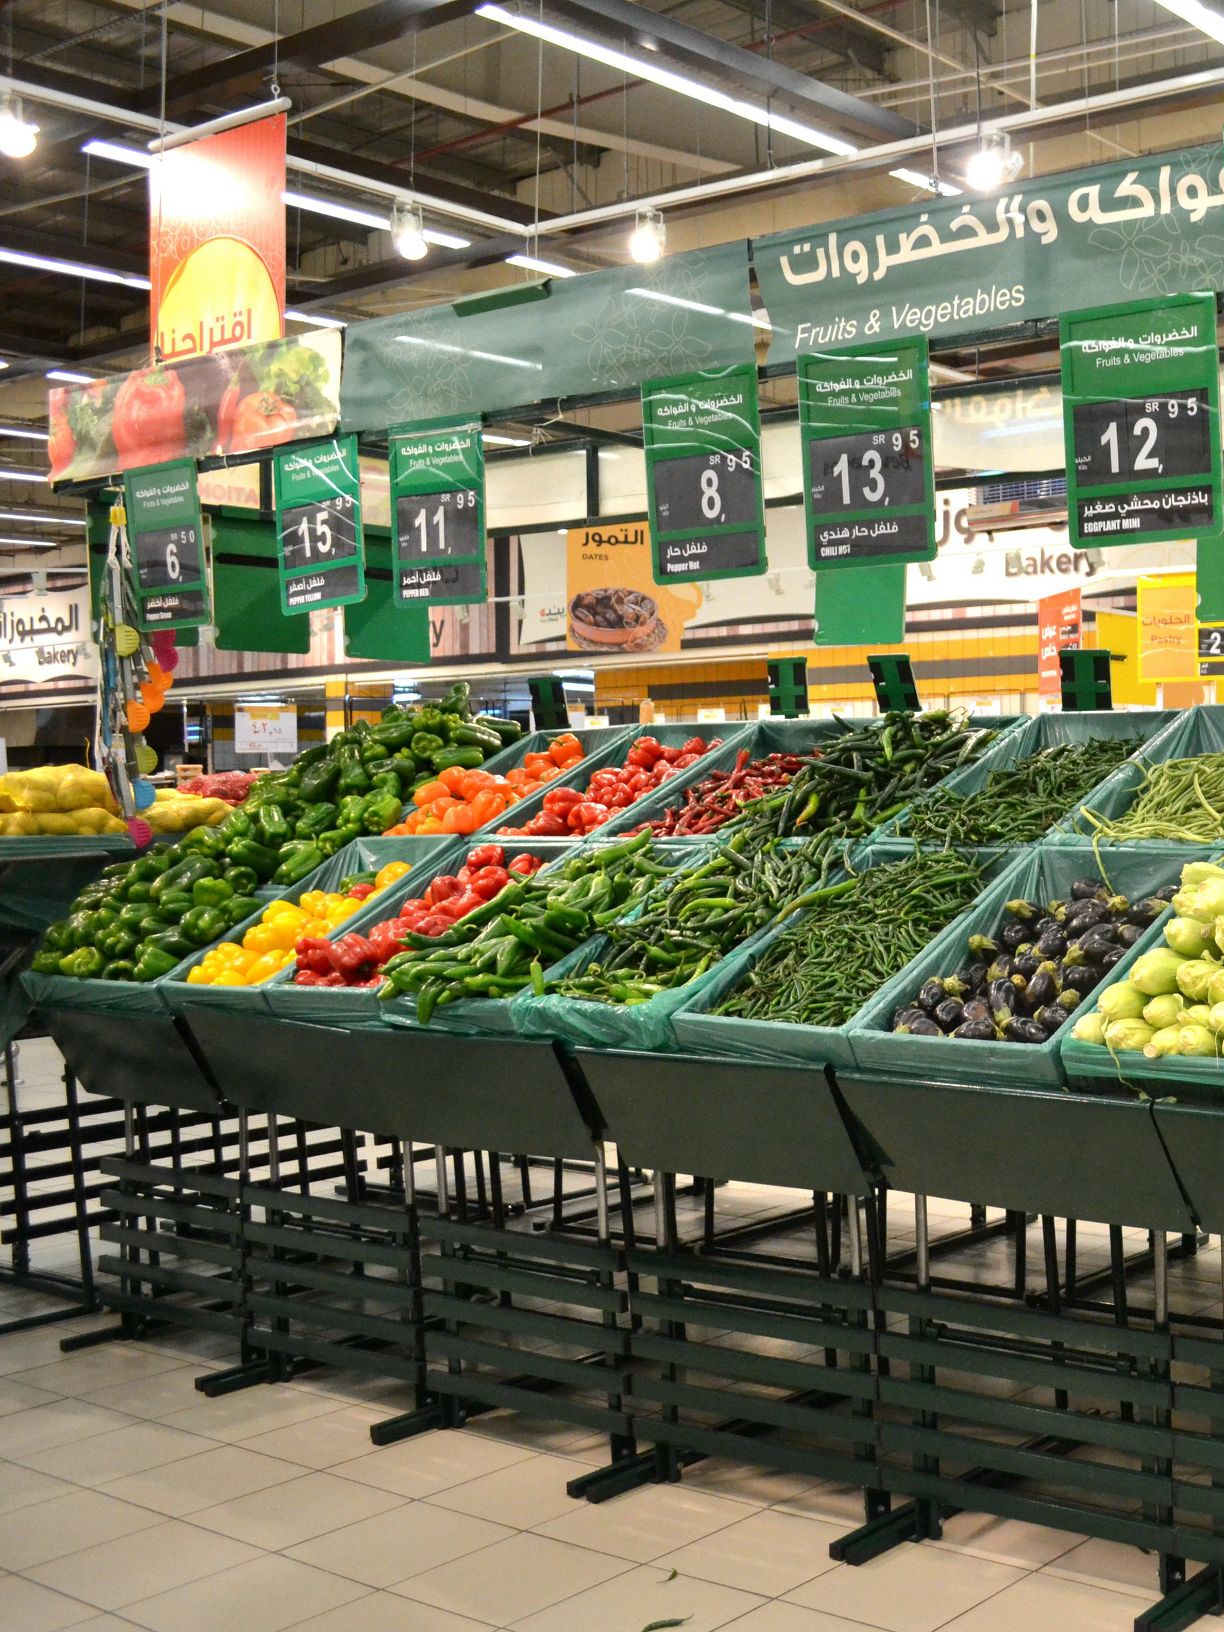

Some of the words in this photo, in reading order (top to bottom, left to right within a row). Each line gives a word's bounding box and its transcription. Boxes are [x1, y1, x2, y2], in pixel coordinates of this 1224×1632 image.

[795, 318, 857, 348] Fruits
[864, 310, 881, 334] &
[892, 284, 1024, 332] Vegetables
[1139, 326, 1197, 344] الخضروات
[1096, 357, 1121, 367] Fruits
[1124, 354, 1130, 364] &
[1133, 348, 1184, 363] Vegetables
[864, 369, 913, 386] الخضروات
[828, 396, 849, 406] Fruits
[851, 394, 857, 403] &
[859, 388, 901, 402] Vegetables
[658, 402, 689, 416] الفواكه
[1145, 402, 1159, 412] SR
[668, 416, 687, 428] Fruits
[688, 416, 693, 426] &
[695, 412, 734, 425] Vegetables
[873, 434, 885, 445] SR
[401, 444, 427, 456] الفواكه
[409, 458, 425, 467] Fruits
[426, 456, 430, 466] &
[431, 454, 463, 466] Vegetables
[709, 456, 720, 465] SR
[441, 493, 450, 502] SR
[1118, 495, 1160, 515] محشي
[1162, 491, 1208, 507] باذنجان
[1084, 500, 1115, 516] صغير
[852, 525, 868, 539] حار
[870, 521, 898, 536] فلفل
[1084, 520, 1120, 533] EGGPLANT
[1122, 518, 1140, 529] MINI
[582, 529, 643, 547] التمور
[820, 527, 849, 544] هندي
[667, 545, 681, 558] حار
[682, 542, 707, 557] فلفل
[821, 546, 838, 557] CHILI
[668, 563, 688, 572] Pepper
[307, 576, 325, 590] فلفل
[420, 570, 441, 583] فلفل
[0, 603, 79, 644] المخبوزا
[38, 644, 78, 666] akery
